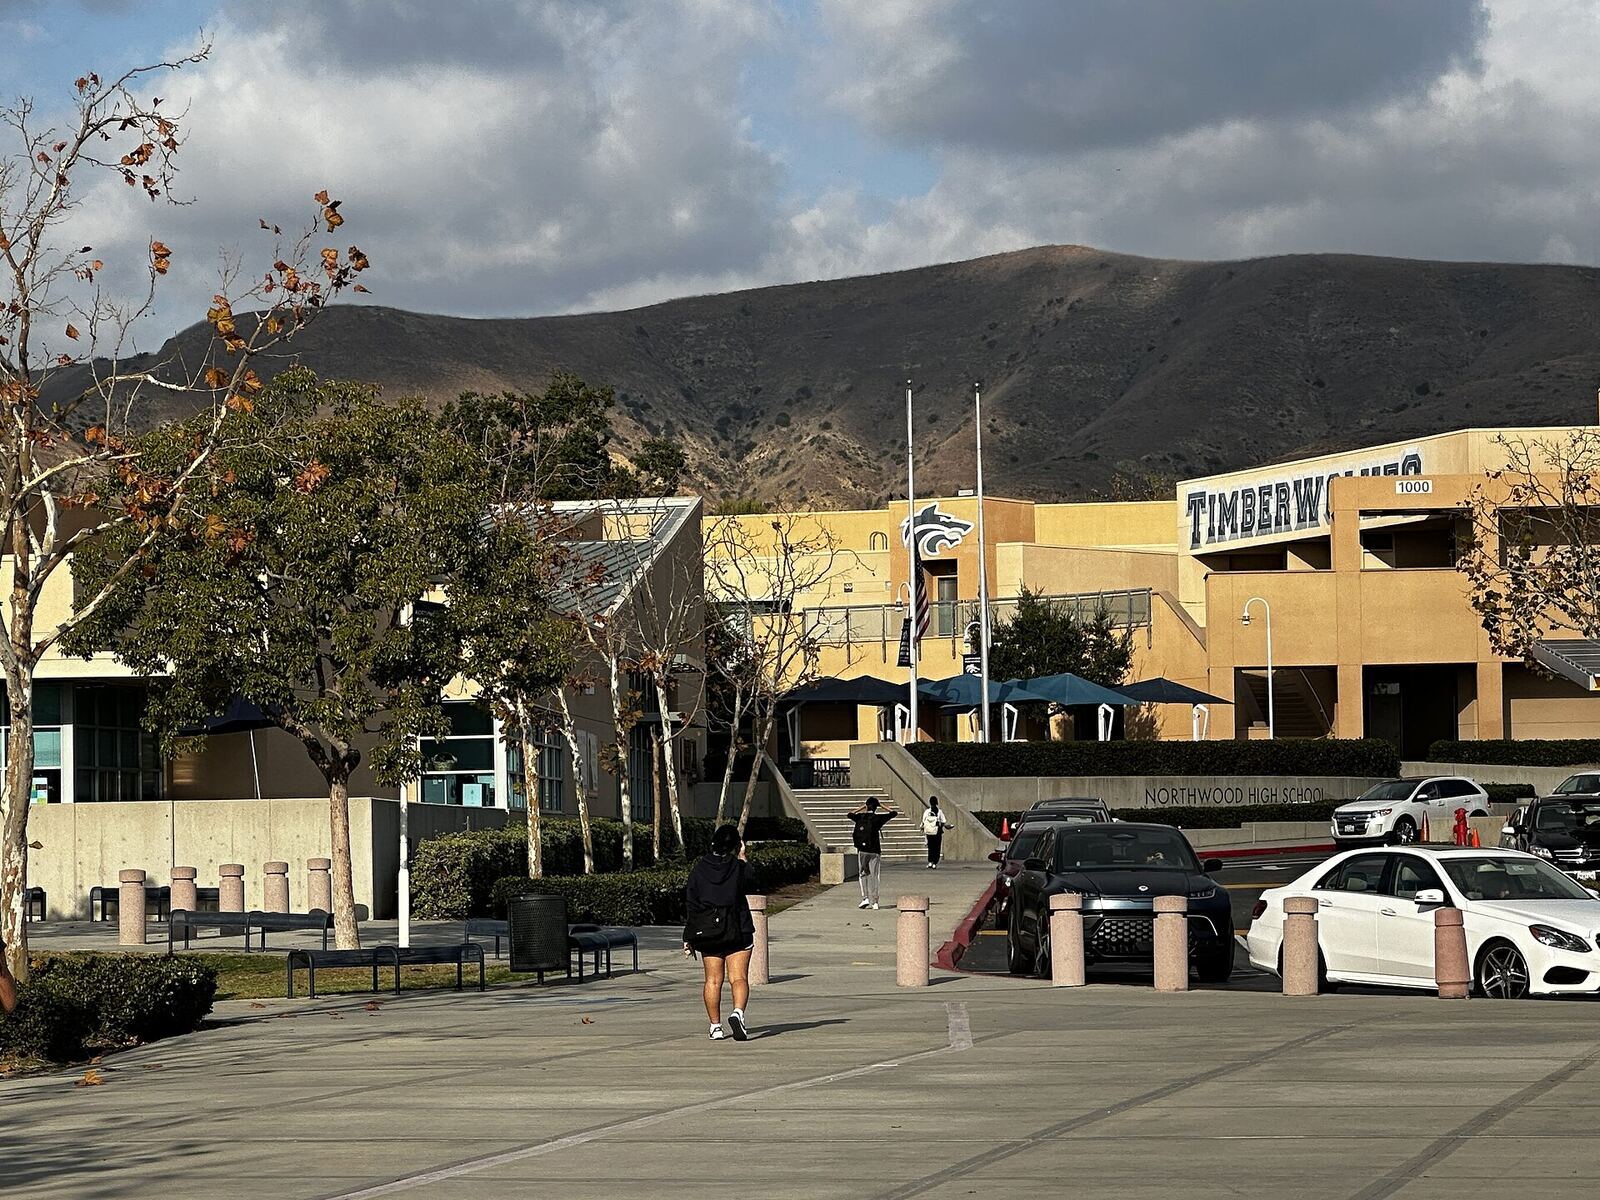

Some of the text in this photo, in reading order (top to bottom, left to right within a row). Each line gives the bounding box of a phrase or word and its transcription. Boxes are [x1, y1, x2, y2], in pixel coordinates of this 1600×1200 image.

[1398, 481, 1430, 493] 1000
[1187, 453, 1422, 549] TIMBERW
[1145, 787, 1243, 805] NORTHWOOD
[1249, 787, 1278, 804] HIGH
